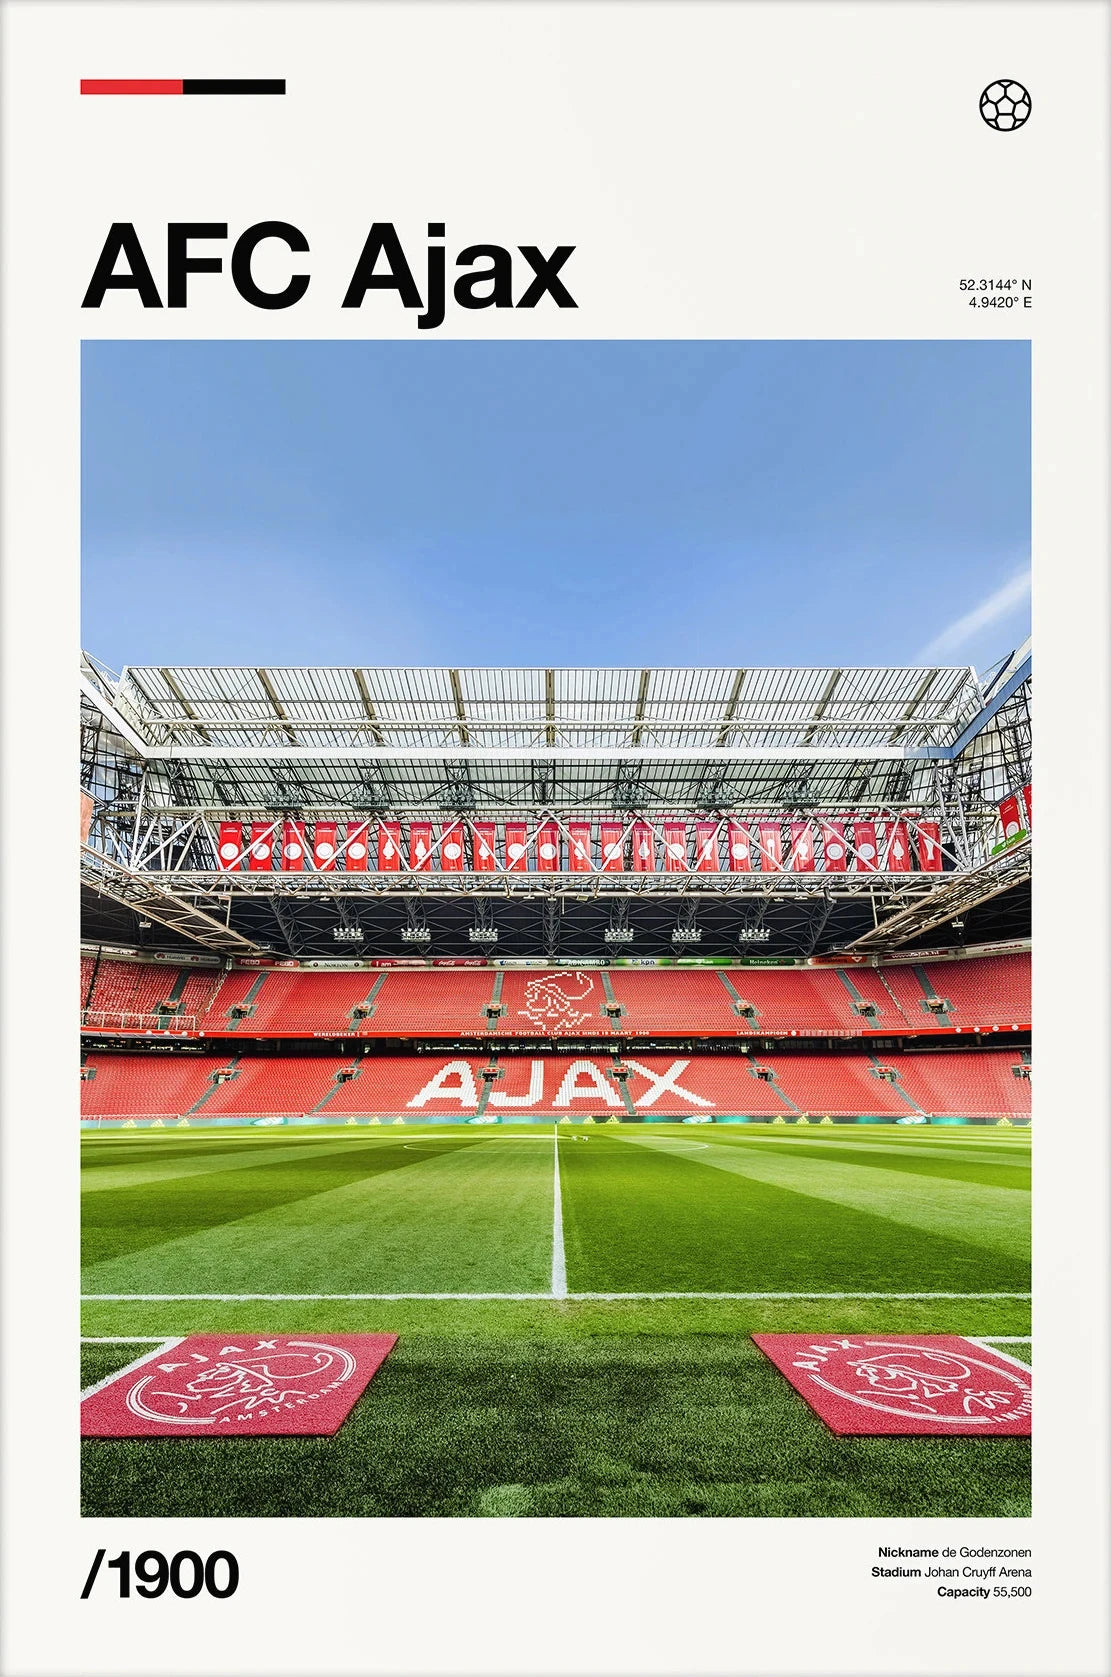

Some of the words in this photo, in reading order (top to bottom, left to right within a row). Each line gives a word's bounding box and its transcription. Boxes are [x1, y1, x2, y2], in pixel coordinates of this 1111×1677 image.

[81, 221, 311, 311] AFC
[341, 222, 579, 330] Ajax
[959, 279, 1018, 291] 52.3144°
[1022, 279, 1032, 291] N
[968, 296, 1019, 308] 4.9420°
[1023, 296, 1032, 308] E
[405, 1060, 716, 1107] AJAX
[156, 1338, 280, 1373] AJAX
[792, 1338, 863, 1373] AJAX
[218, 1381, 344, 1424] AMSTERDAM
[879, 1547, 939, 1558] Nickname
[942, 1547, 957, 1558] de
[959, 1547, 1032, 1558] Godenzonen
[80, 1549, 240, 1600] /1900
[871, 1567, 922, 1578] Stadium
[924, 1567, 959, 1578] Johan
[962, 1566, 996, 1580] Cruyff
[999, 1567, 1032, 1578] Arena
[937, 1586, 990, 1599] Capacity
[993, 1586, 1032, 1599] 55,500
